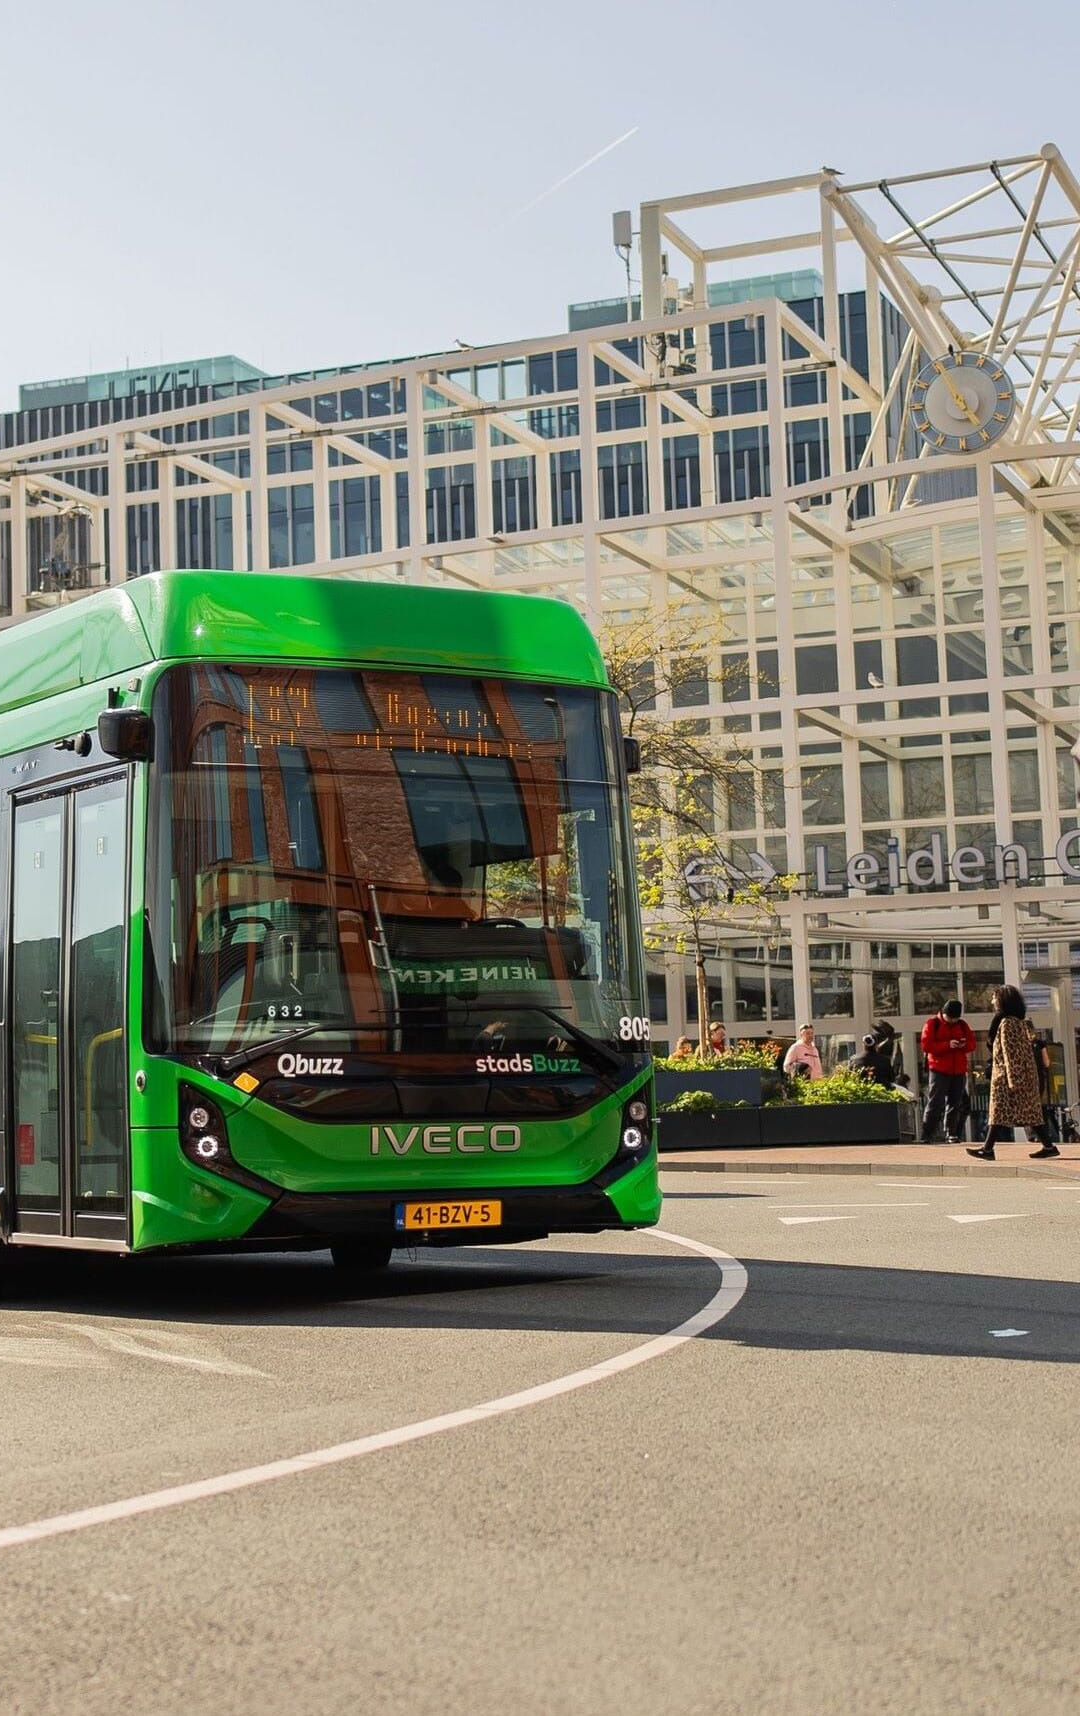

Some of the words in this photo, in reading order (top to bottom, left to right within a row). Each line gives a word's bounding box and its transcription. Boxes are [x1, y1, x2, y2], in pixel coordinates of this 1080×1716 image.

[815, 833, 1029, 893] Leiden
[277, 1053, 344, 1077] Qbuzz
[371, 1124, 521, 1155] IVECO
[412, 1204, 491, 1225] 41-BZV-5
